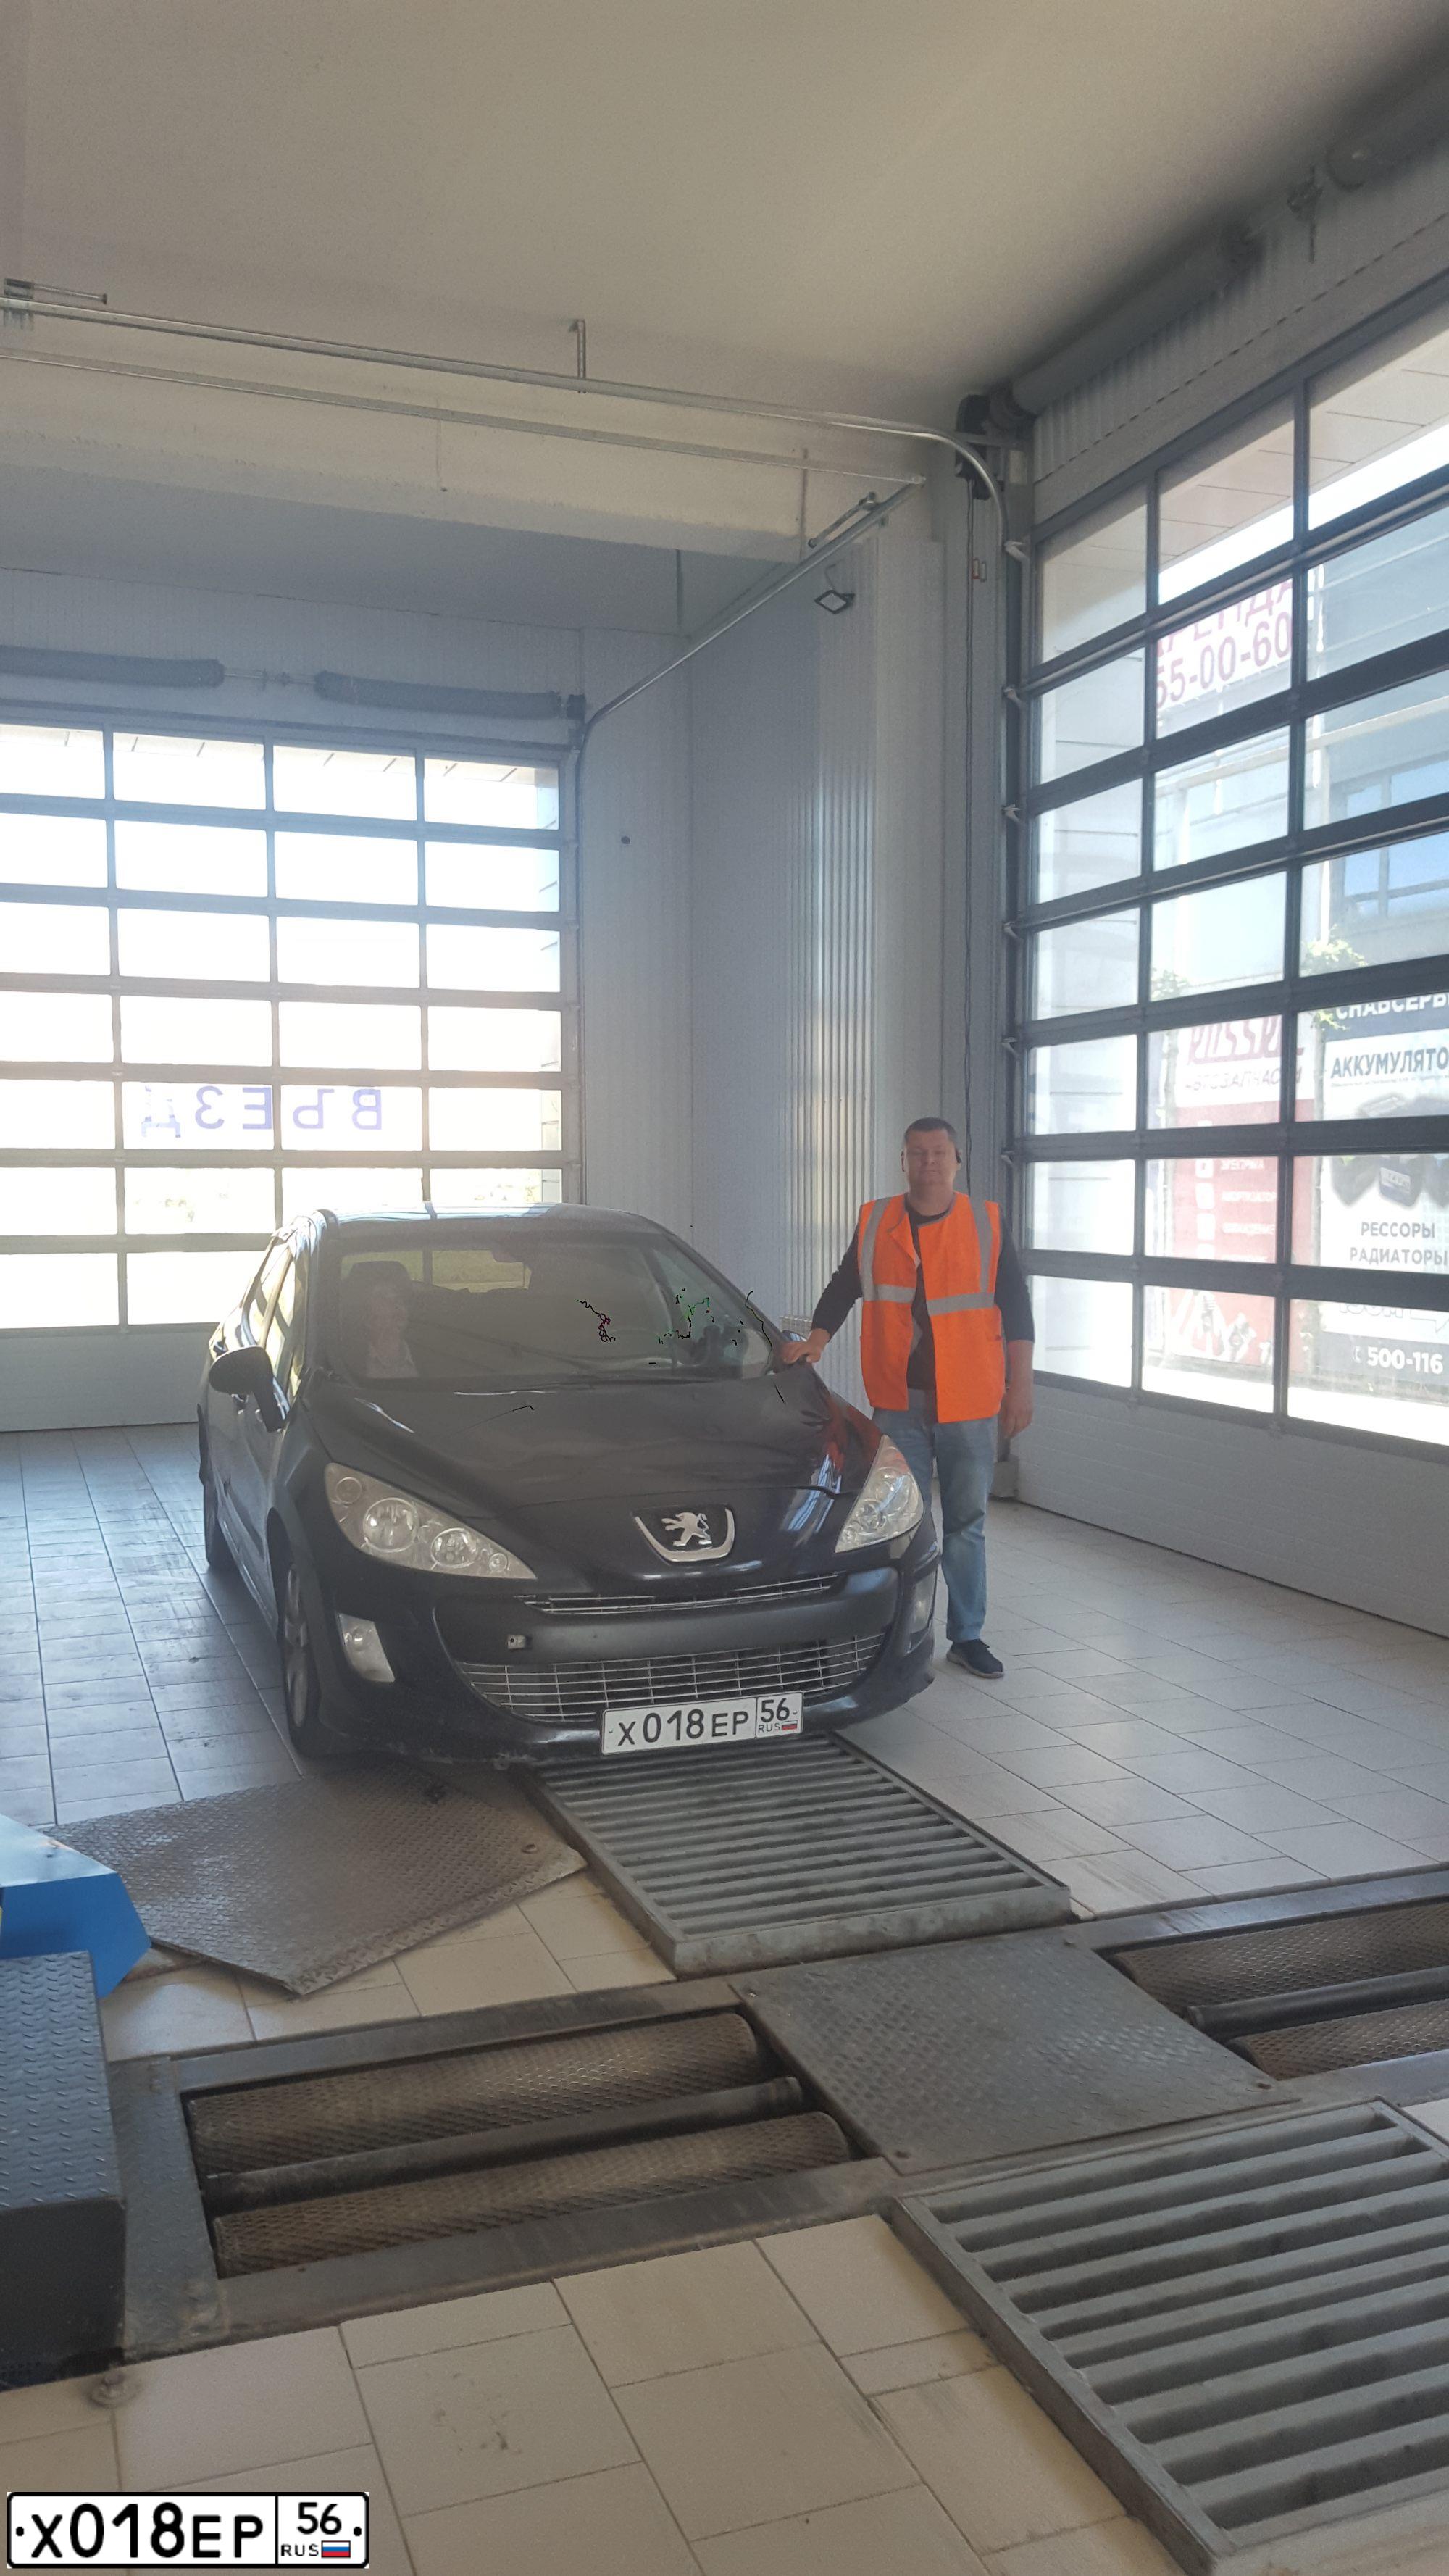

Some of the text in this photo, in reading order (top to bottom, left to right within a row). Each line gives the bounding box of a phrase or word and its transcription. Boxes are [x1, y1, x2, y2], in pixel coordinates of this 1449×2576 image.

[1361, 1221, 1435, 1239] РЕССОРЫ
[1350, 1246, 1448, 1266] РАДИАТОРЫ
[1366, 1346, 1444, 1375] 500-116
[760, 1698, 790, 1722] 56
[758, 1723, 780, 1733] RUS
